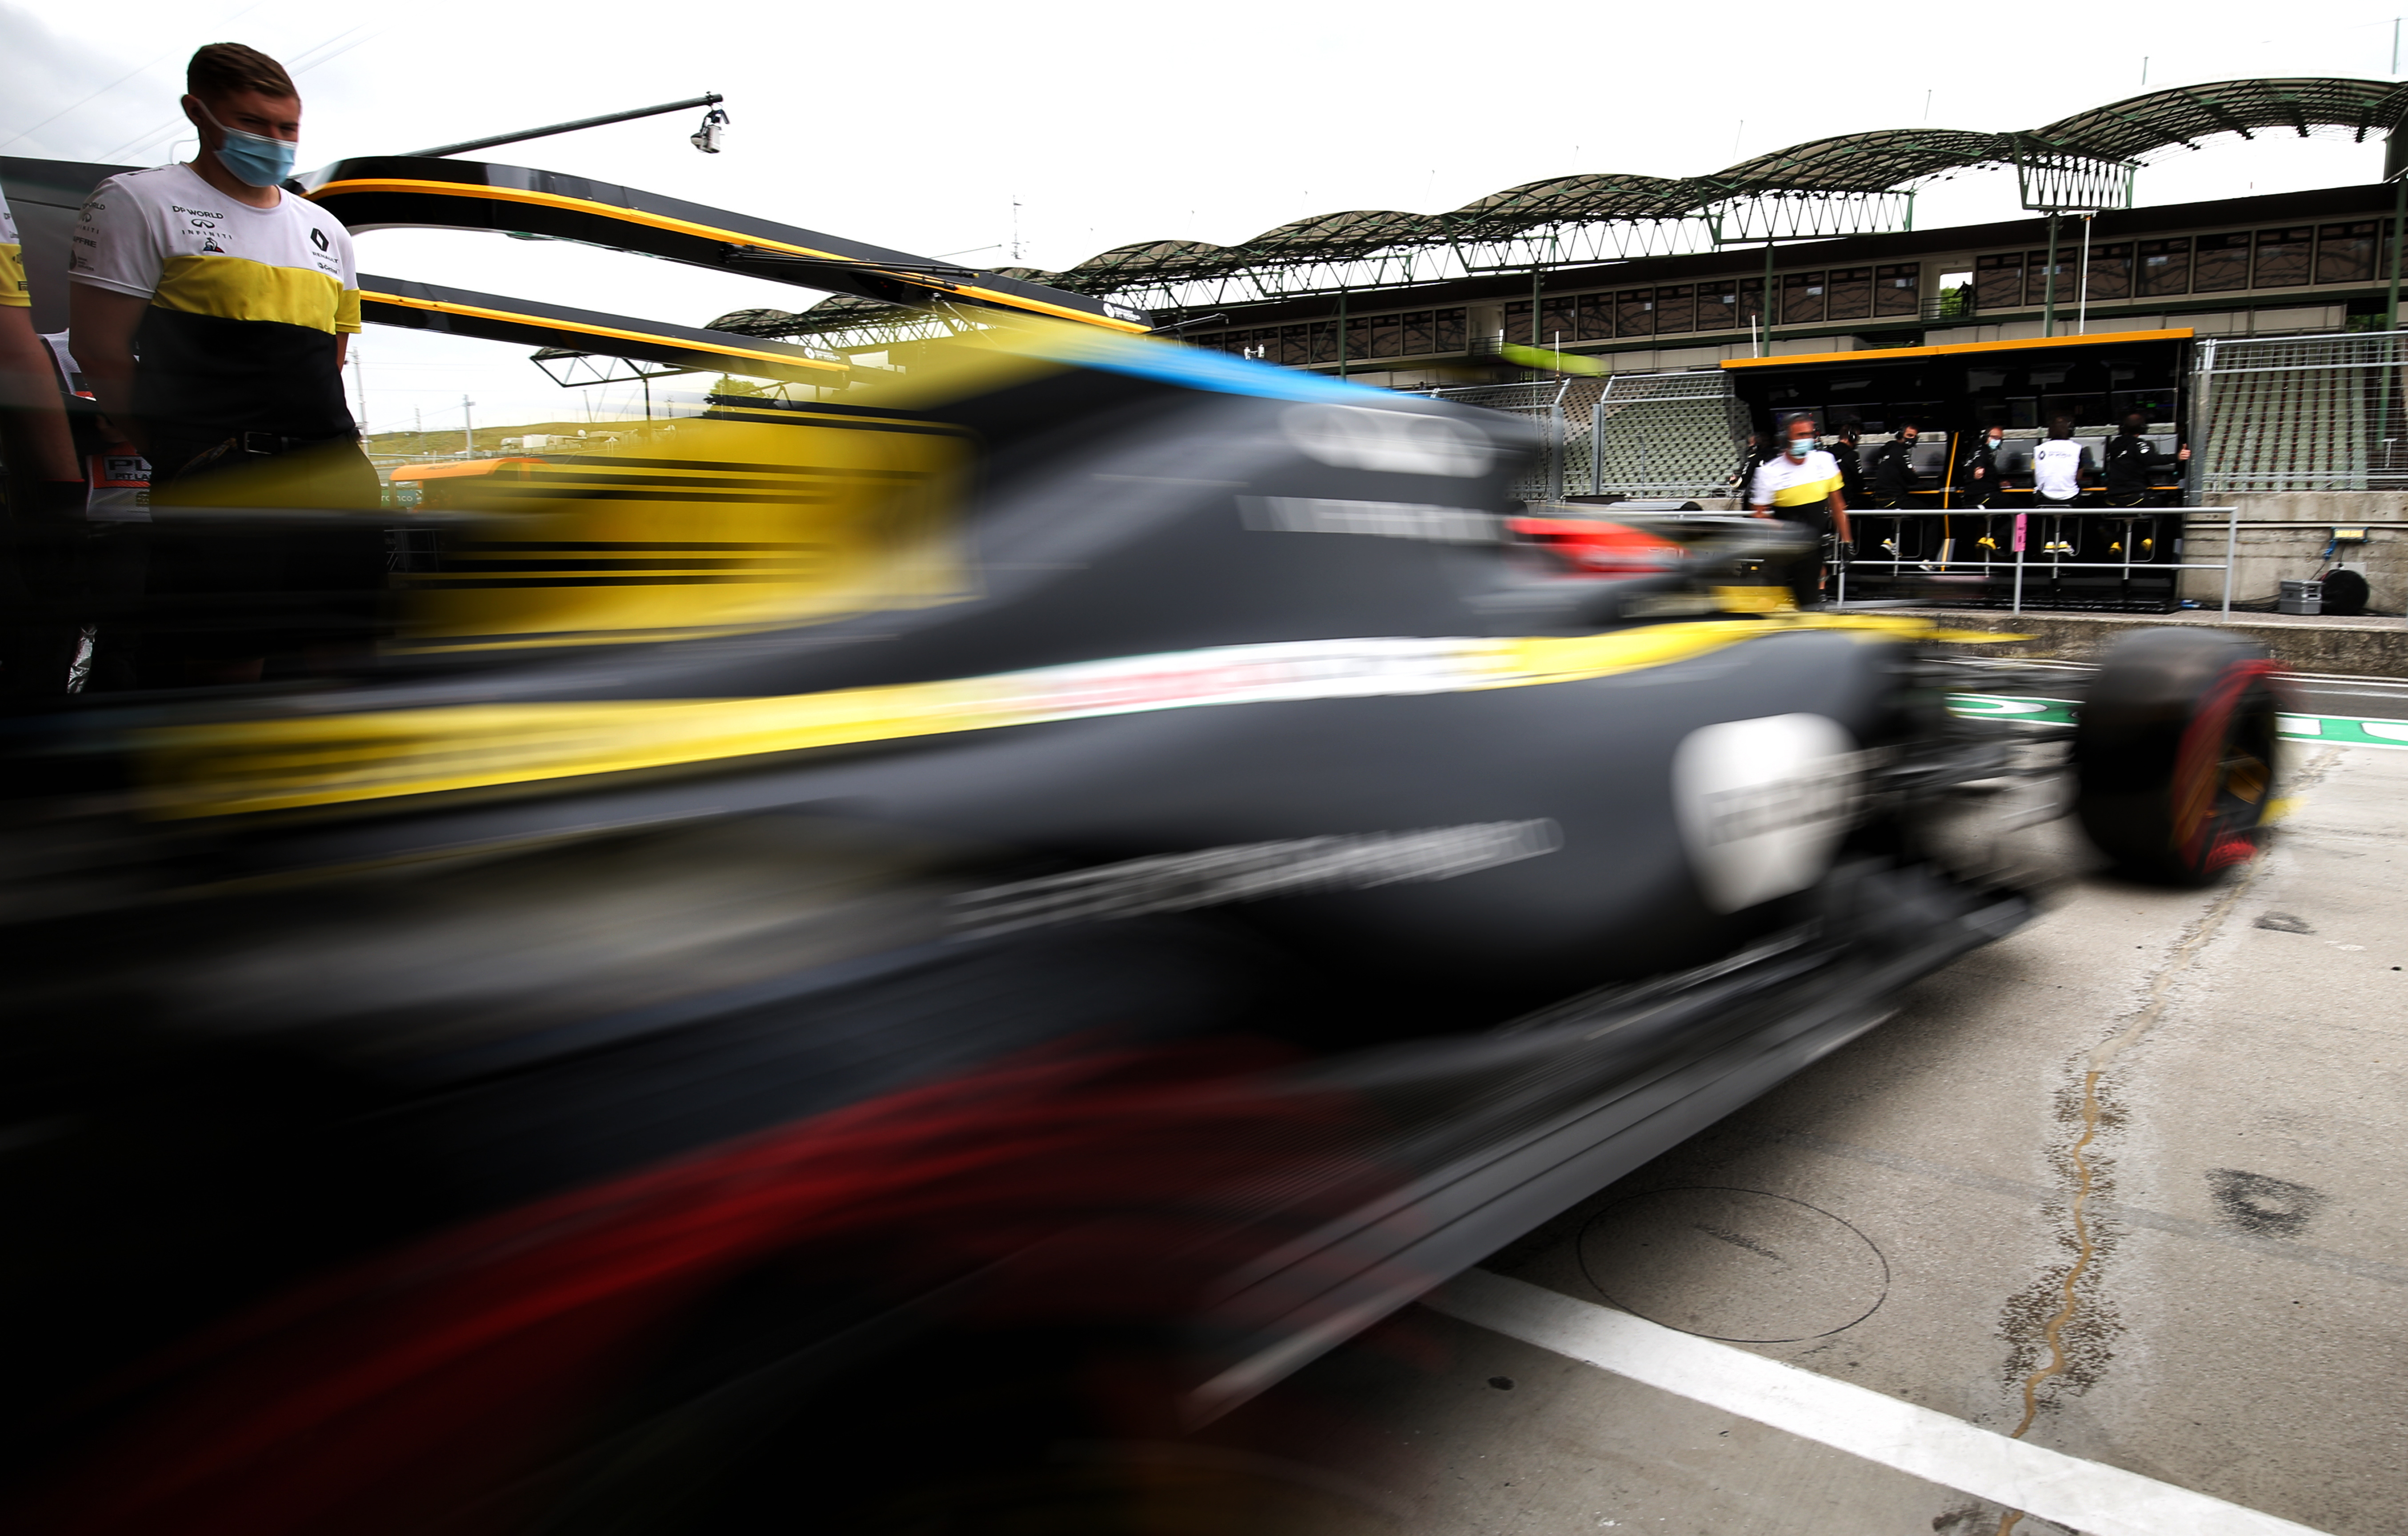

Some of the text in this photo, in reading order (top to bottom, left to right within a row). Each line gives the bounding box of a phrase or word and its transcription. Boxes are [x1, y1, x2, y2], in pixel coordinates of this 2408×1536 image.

[187, 208, 224, 219] WORLD
[182, 229, 232, 240] INFINITI
[312, 251, 338, 264] RENAULT
